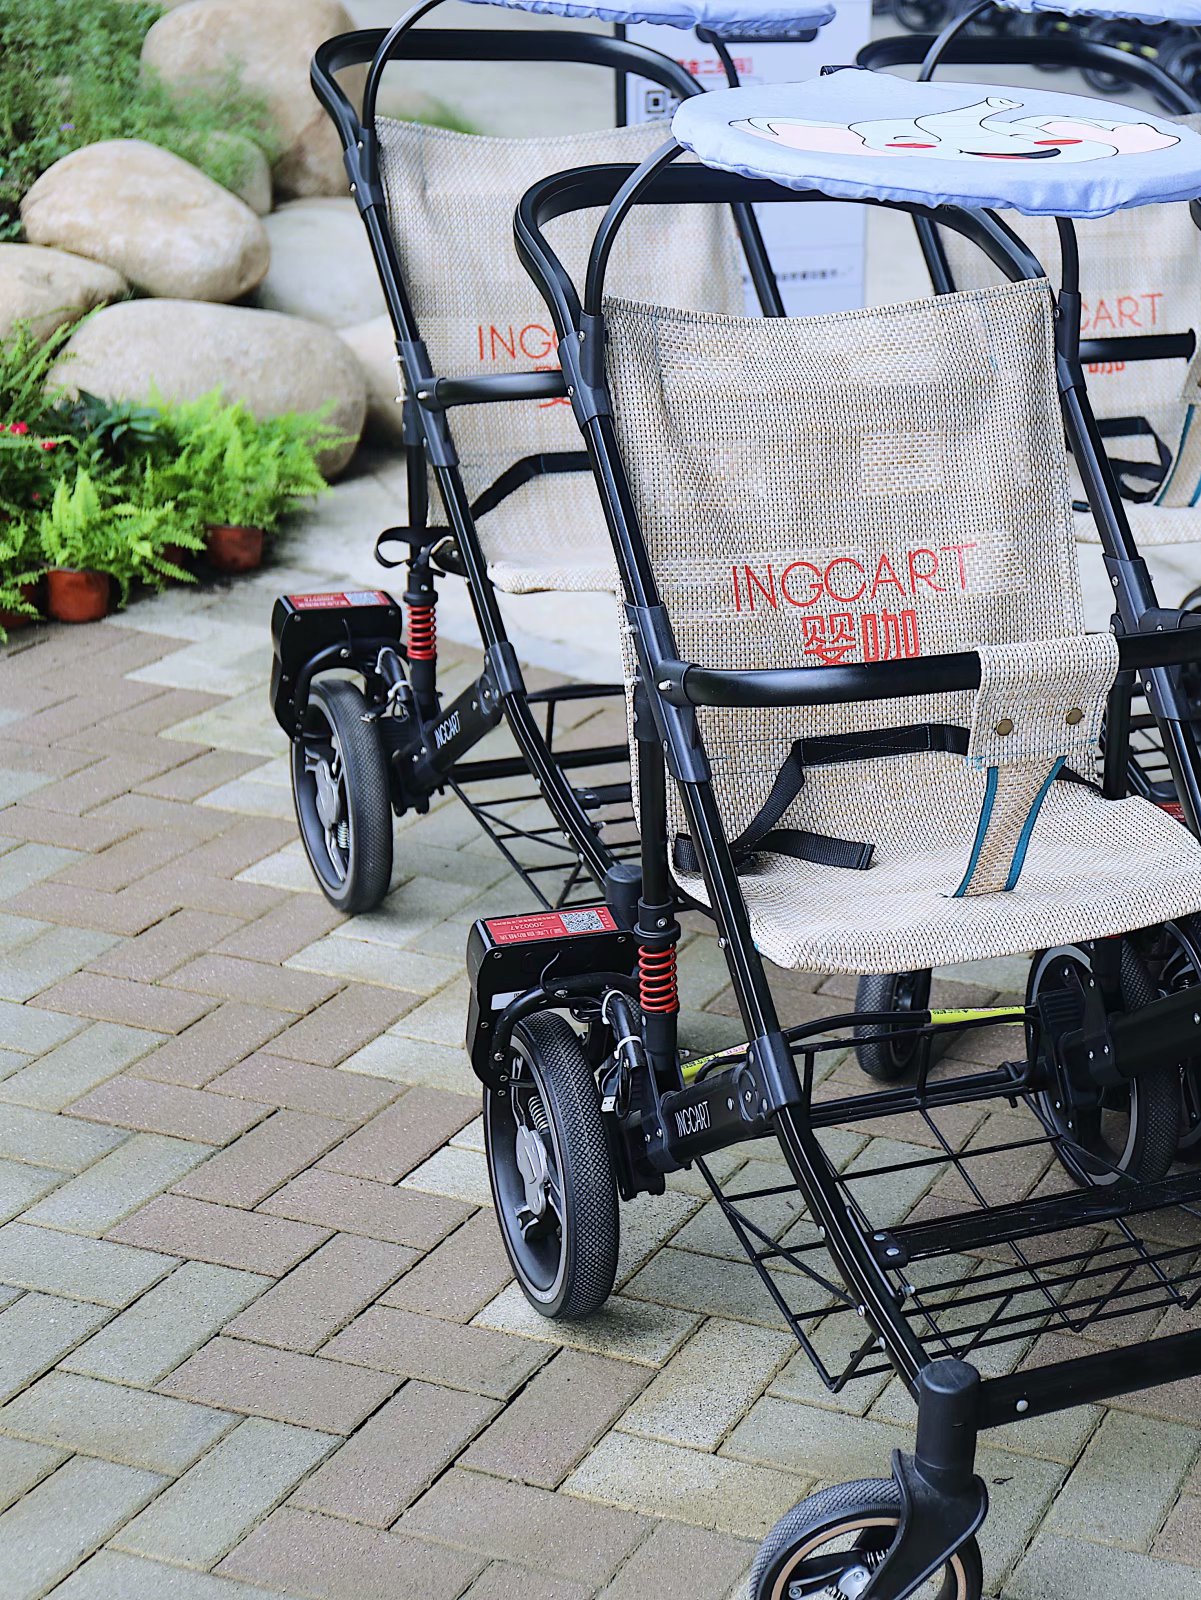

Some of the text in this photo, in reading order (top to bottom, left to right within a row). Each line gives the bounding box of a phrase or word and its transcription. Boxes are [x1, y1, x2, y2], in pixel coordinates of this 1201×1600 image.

[478, 323, 558, 361] ING
[732, 543, 978, 612] INGCART
[800, 607, 921, 666] 婴咖
[674, 1100, 711, 1138] INGCART
